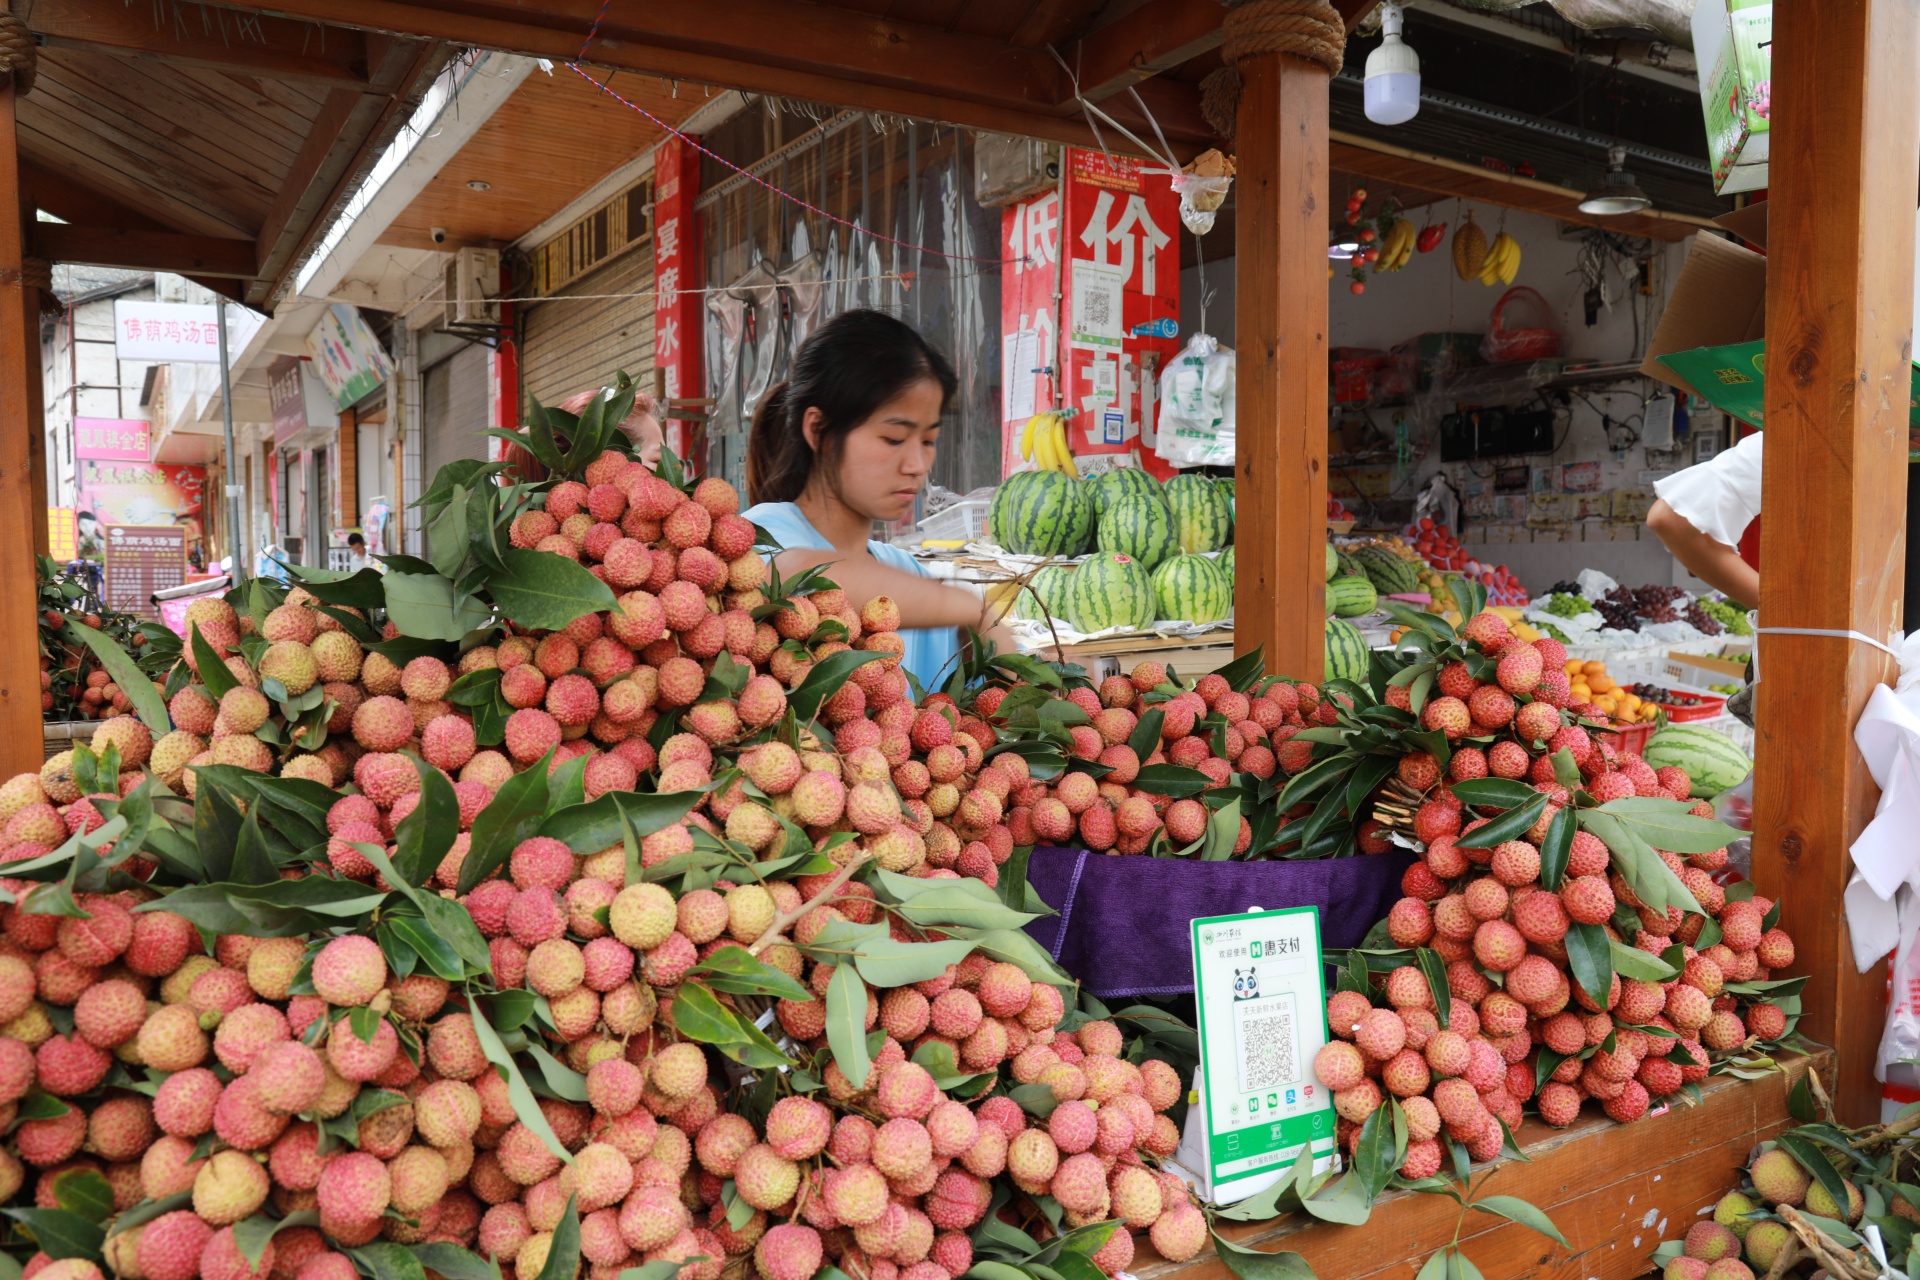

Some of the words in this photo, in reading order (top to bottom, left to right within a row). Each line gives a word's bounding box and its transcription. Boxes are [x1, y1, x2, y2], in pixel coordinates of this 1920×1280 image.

[1218, 947, 1247, 959] 欢迎使用
[1264, 936, 1300, 957] 惠支付
